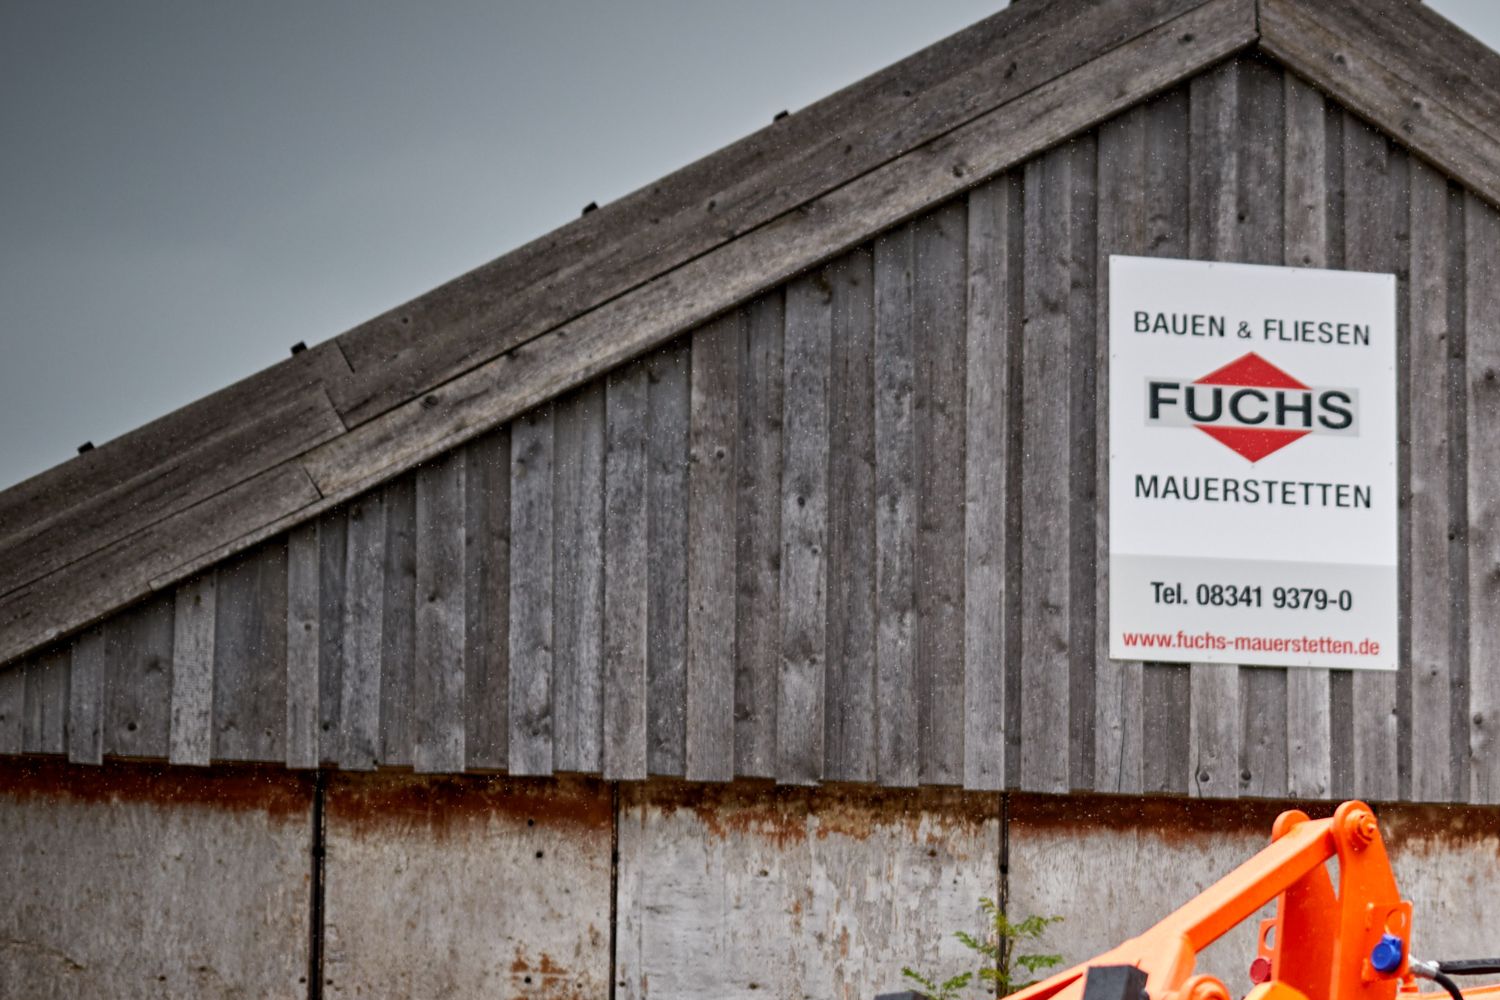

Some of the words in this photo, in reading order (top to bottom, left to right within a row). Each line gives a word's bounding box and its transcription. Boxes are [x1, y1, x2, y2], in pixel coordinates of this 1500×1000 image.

[1133, 311, 1225, 338] BAUEN
[1236, 320, 1252, 339] &
[1263, 318, 1371, 346] FLIESEN
[1148, 381, 1353, 430] FUCHS
[1135, 474, 1371, 509] MAUERSTETTEN
[1150, 581, 1188, 605] Tel.
[1196, 583, 1262, 608] 08341
[1272, 586, 1353, 612] 9379-0
[1122, 630, 1380, 656] www.fuchs-mauerstetten.de
